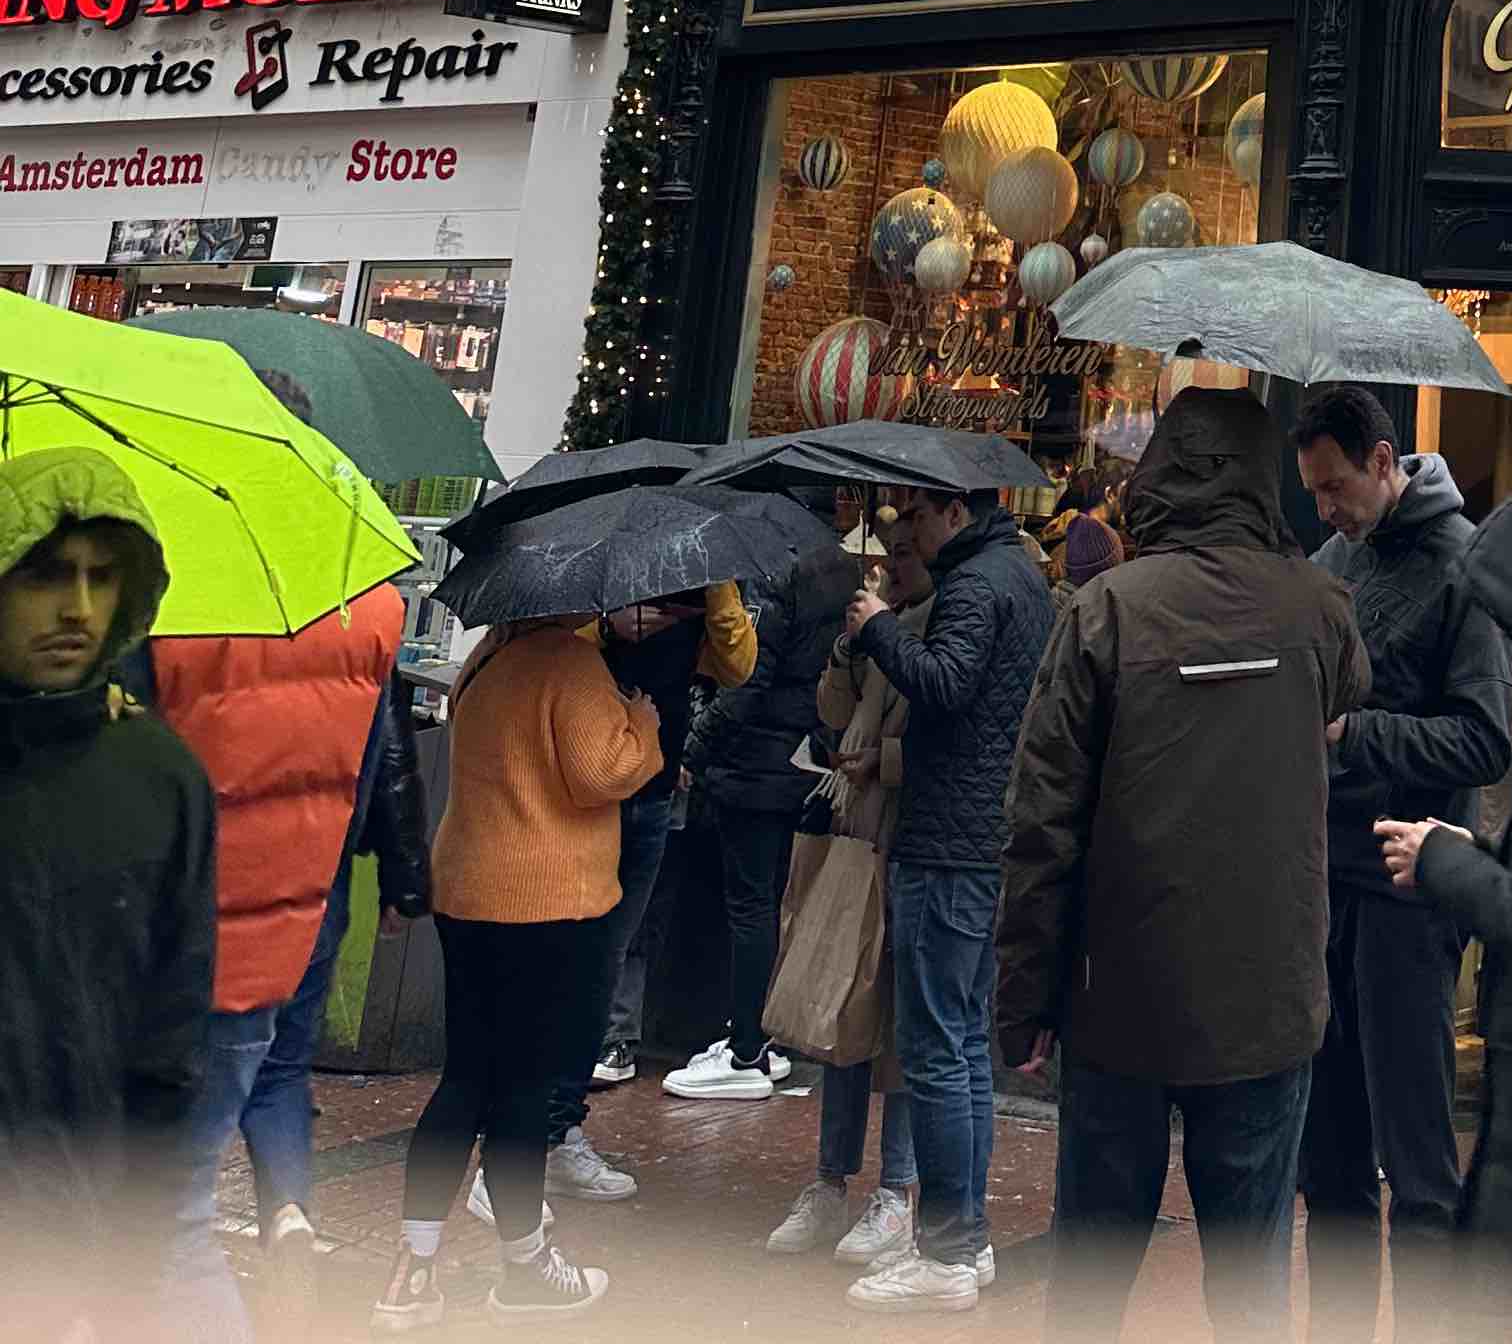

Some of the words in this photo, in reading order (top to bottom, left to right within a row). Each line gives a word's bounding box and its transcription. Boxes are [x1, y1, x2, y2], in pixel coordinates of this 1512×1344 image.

[309, 28, 519, 102] Repair
[0, 148, 204, 192] Amsterdam
[346, 138, 458, 182] Store
[936, 318, 1108, 378] Wonderen
[902, 381, 1049, 435] Stroopwafels
